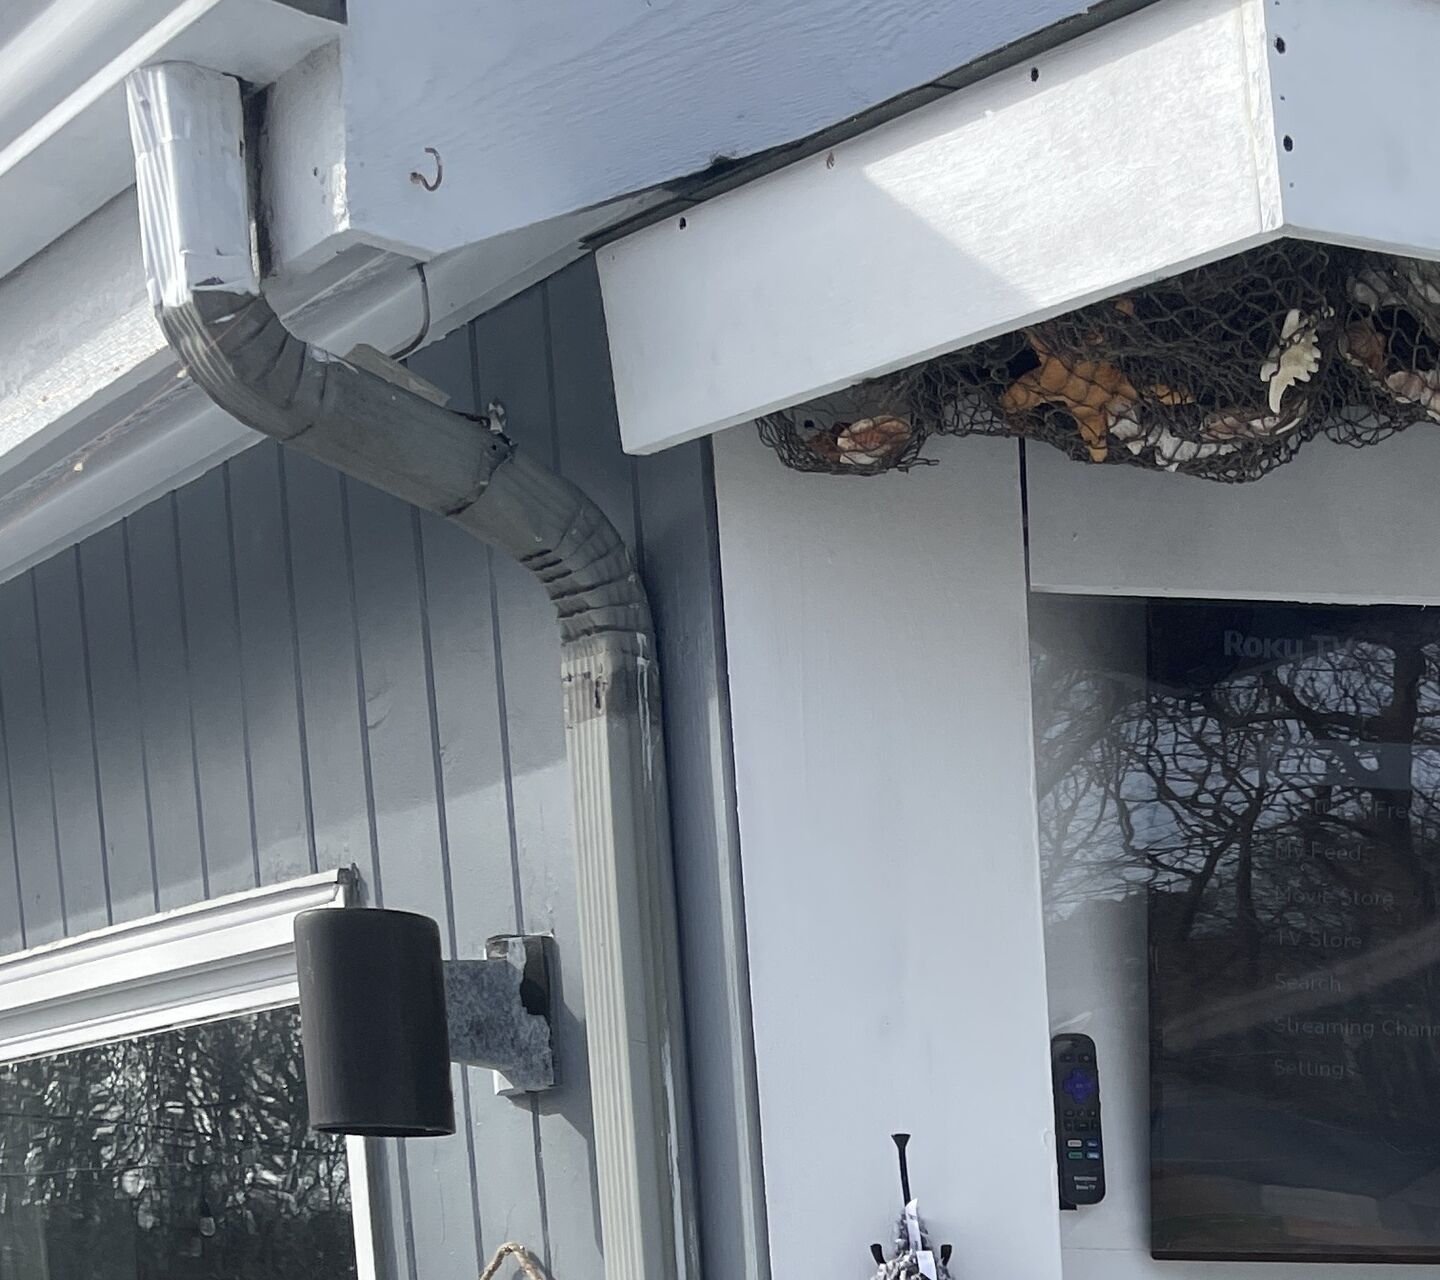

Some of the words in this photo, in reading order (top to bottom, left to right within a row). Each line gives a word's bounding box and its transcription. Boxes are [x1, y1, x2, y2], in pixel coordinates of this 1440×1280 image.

[1223, 629, 1304, 659] Roku
[1273, 1016, 1376, 1041] Streaming
[1273, 1058, 1357, 1081] Settings
